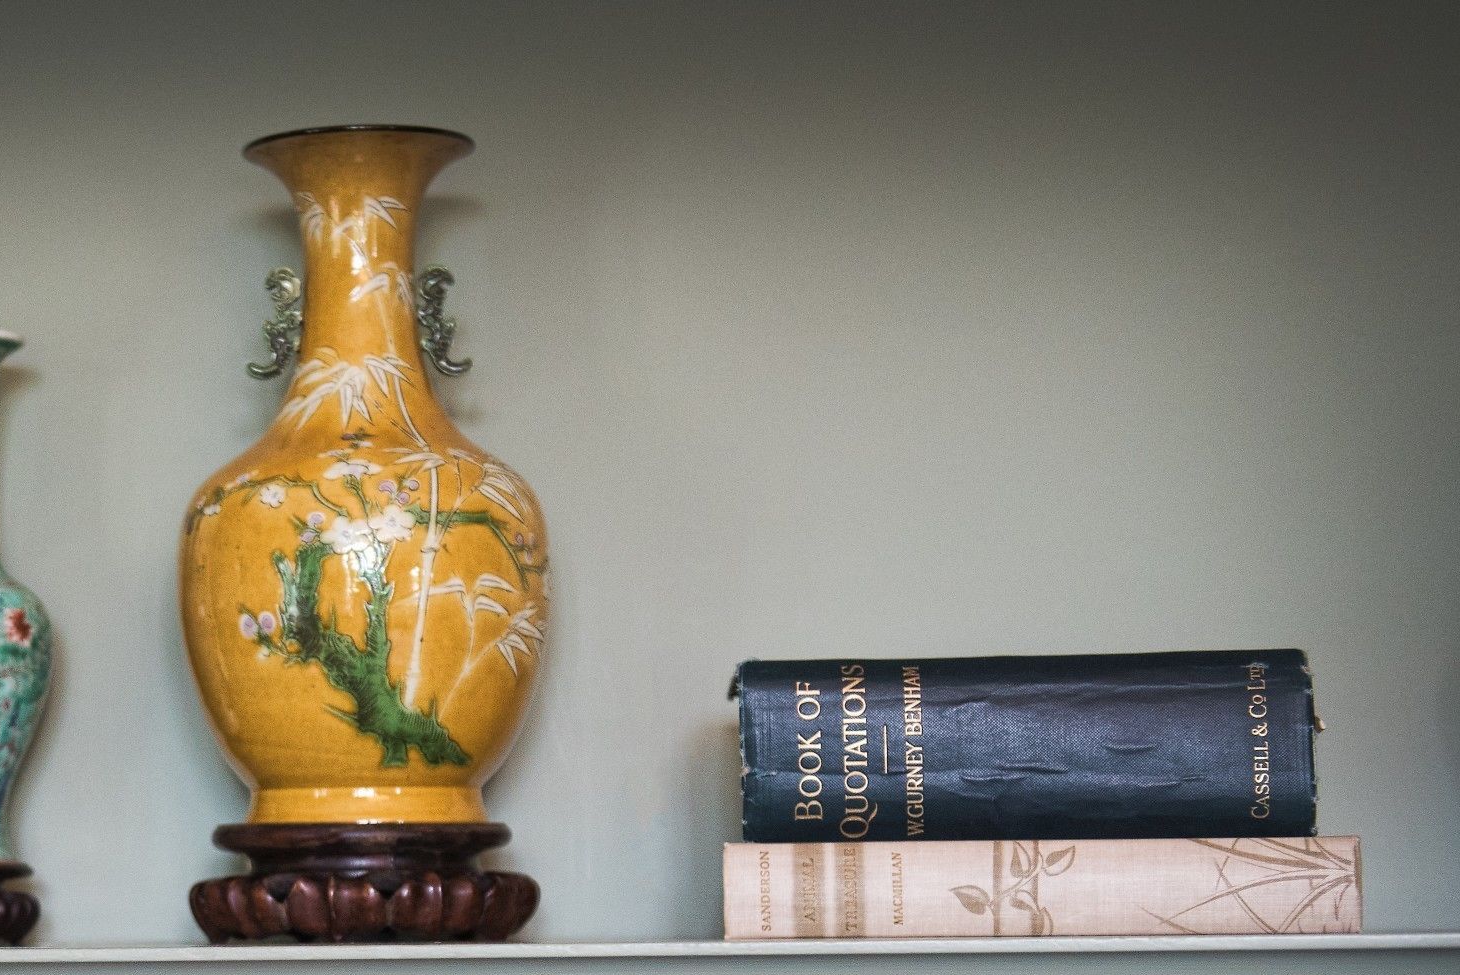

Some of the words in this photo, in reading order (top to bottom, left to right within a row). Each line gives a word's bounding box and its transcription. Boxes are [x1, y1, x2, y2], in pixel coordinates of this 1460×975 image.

[796, 681, 821, 720] OF
[903, 666, 923, 736] BENHAM
[1251, 722, 1268, 737] &
[795, 731, 823, 821] BOOK
[840, 664, 877, 838] QUOTATIONS
[1251, 741, 1270, 819] CASSELL
[760, 851, 772, 932] SANDERSON
[844, 848, 858, 931] TREASURE
[891, 852, 904, 926] MACMILLAN
